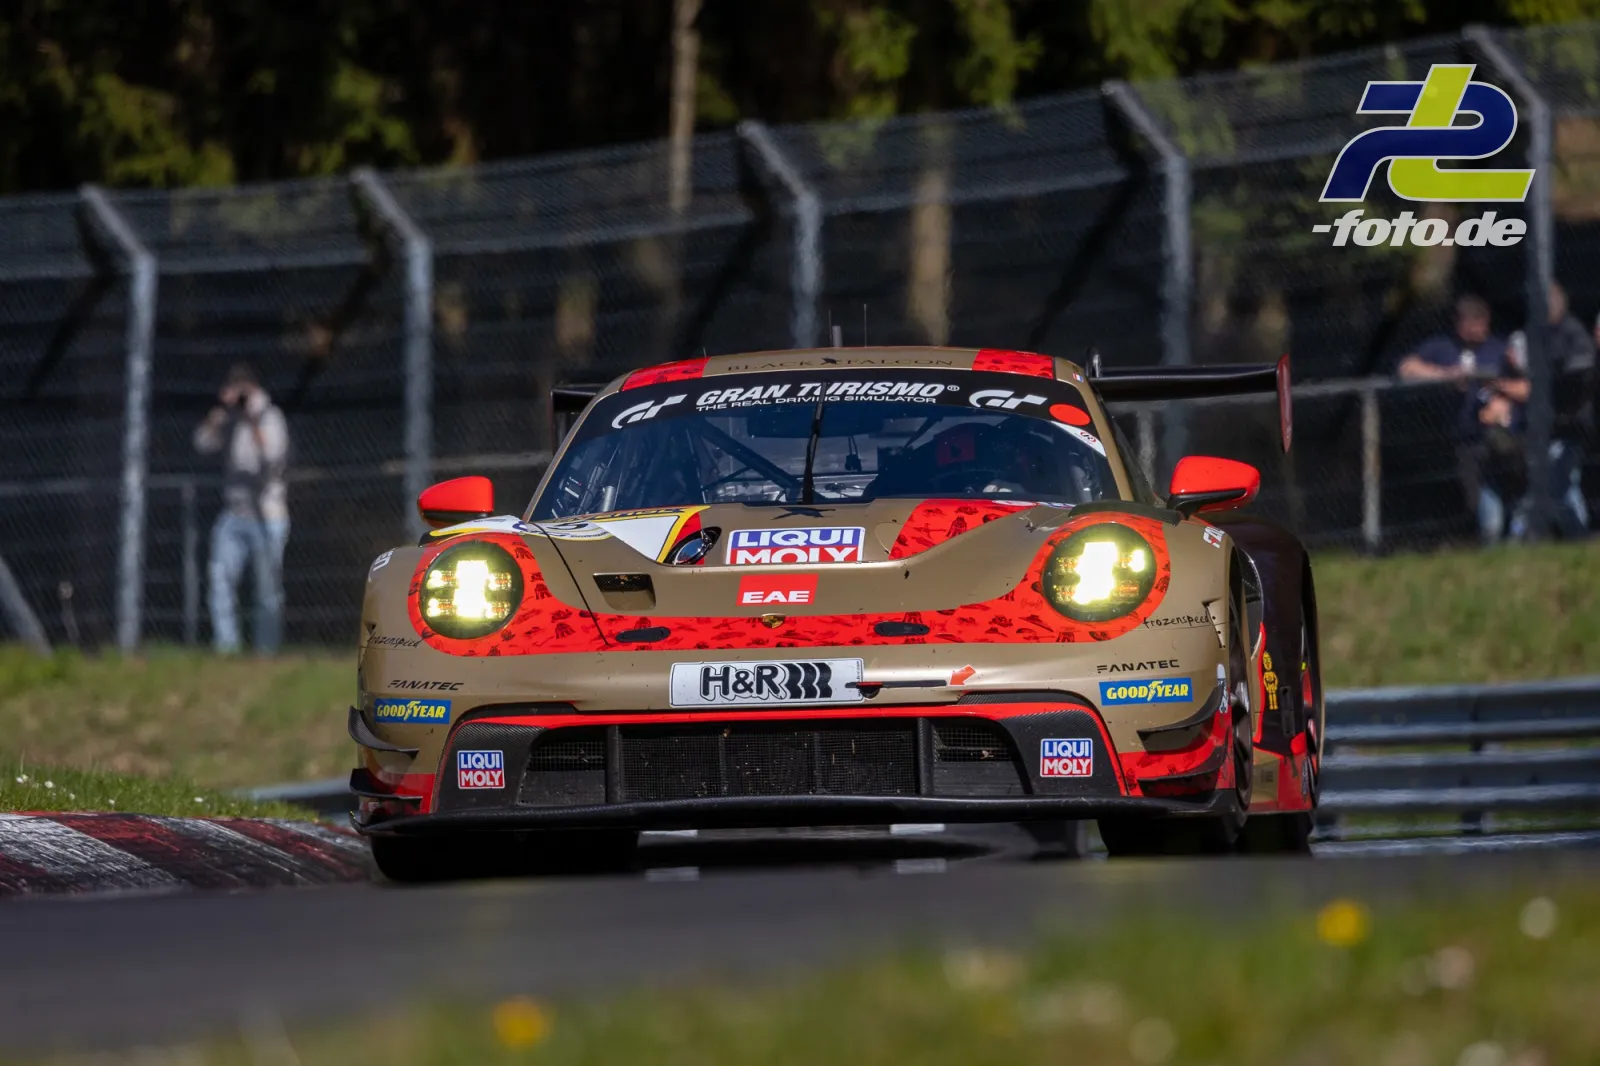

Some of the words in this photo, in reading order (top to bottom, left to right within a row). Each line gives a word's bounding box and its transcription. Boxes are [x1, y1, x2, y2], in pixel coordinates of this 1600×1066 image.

[727, 360, 813, 371] BLACK
[696, 383, 792, 406] GRAN
[696, 402, 727, 412] THE
[731, 398, 771, 408] REAL
[843, 395, 937, 404] SIMULATOR
[737, 529, 855, 547] LIQUI
[741, 590, 810, 604] EAE
[1141, 611, 1211, 629] frozenspeed
[1096, 659, 1180, 674] FANATEC
[387, 679, 464, 691] FANATEC
[700, 664, 788, 701] H&R
[1043, 741, 1091, 757] LIQUI
[460, 752, 501, 768] LIQUI
[1043, 757, 1092, 775] MOLY
[460, 769, 502, 786] MOLY
